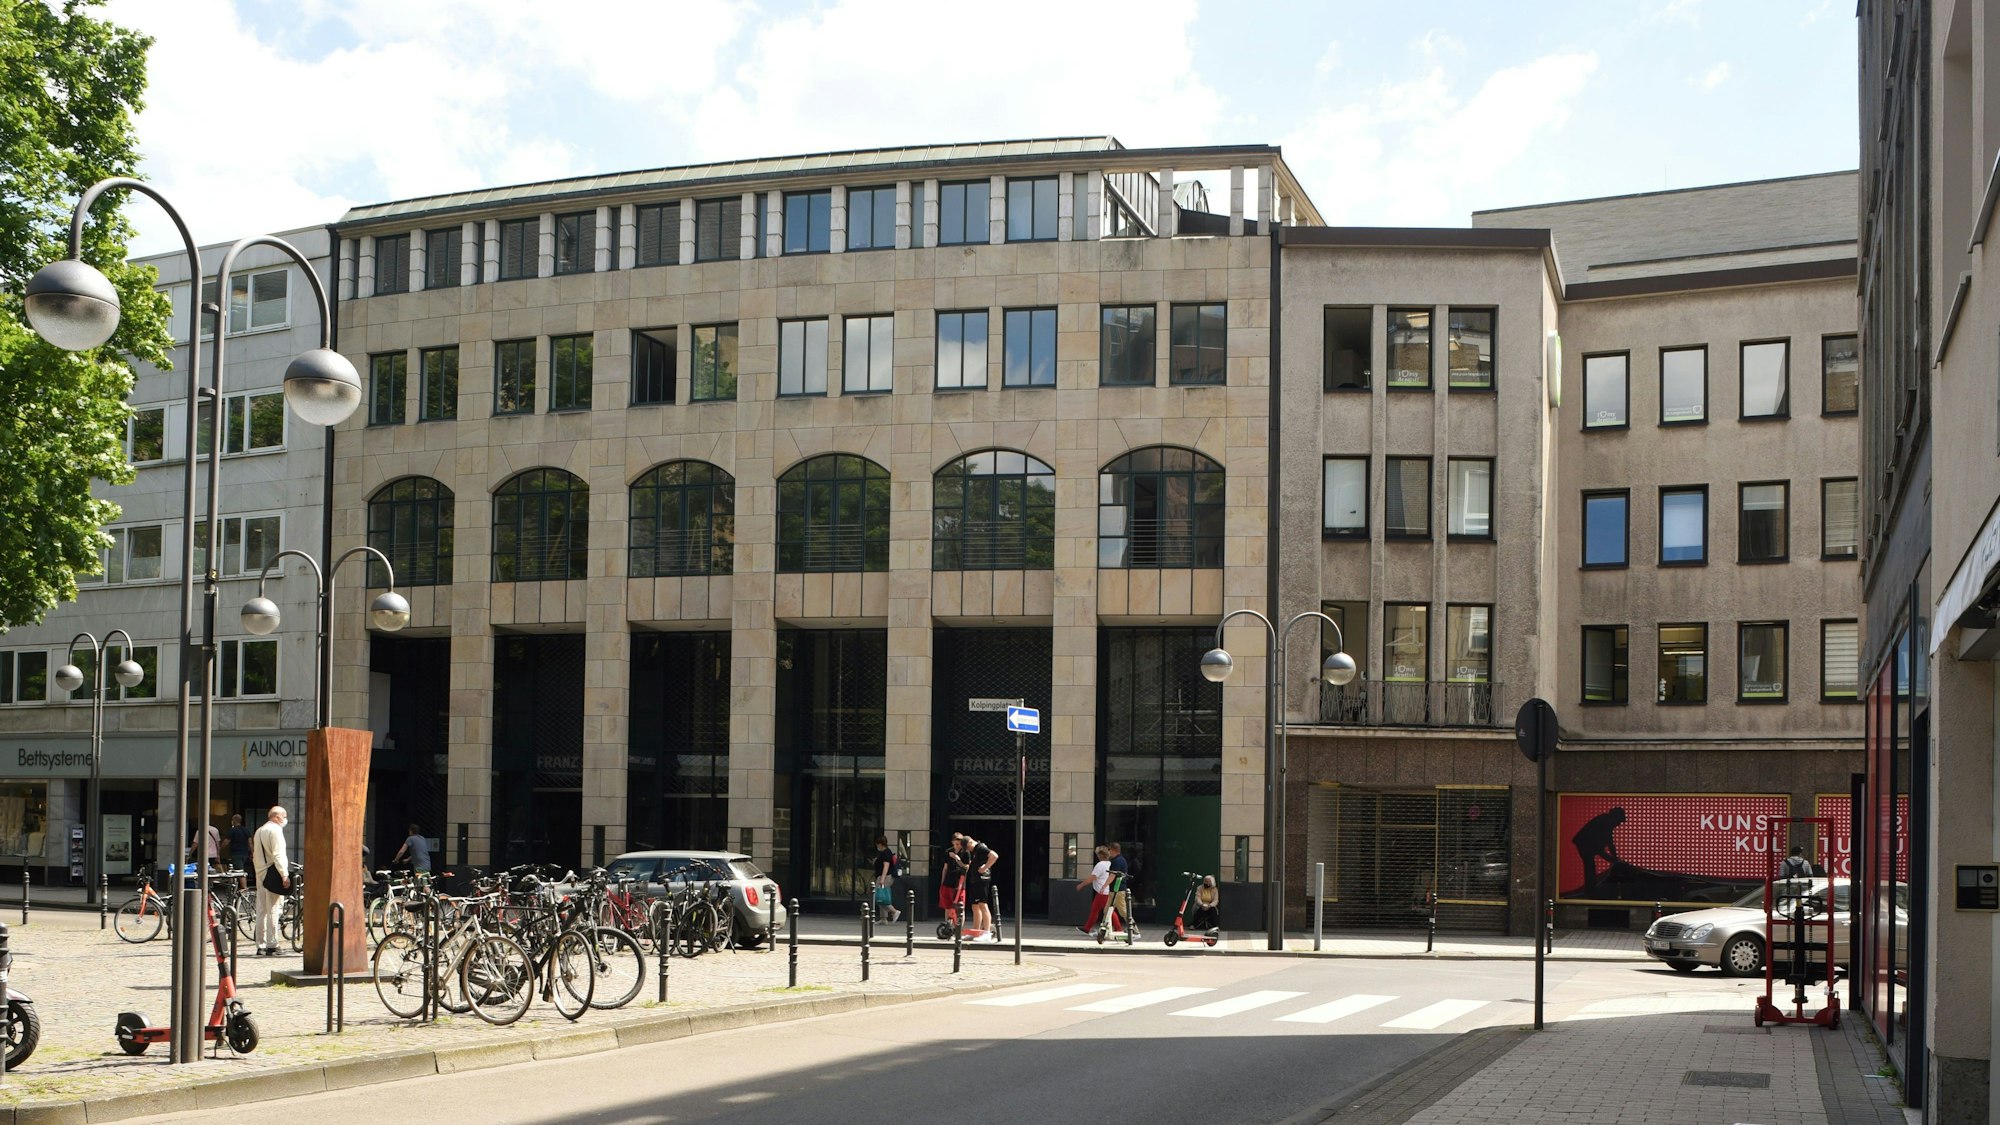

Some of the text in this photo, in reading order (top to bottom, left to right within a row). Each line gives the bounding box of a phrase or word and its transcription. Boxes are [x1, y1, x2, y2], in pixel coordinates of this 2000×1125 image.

[248, 740, 308, 757] AUNOLD
[18, 748, 93, 771] Bettsysteme
[536, 755, 579, 769] FRANZ
[954, 758, 1003, 772] FRANZ
[1700, 814, 1784, 831] KUNST
